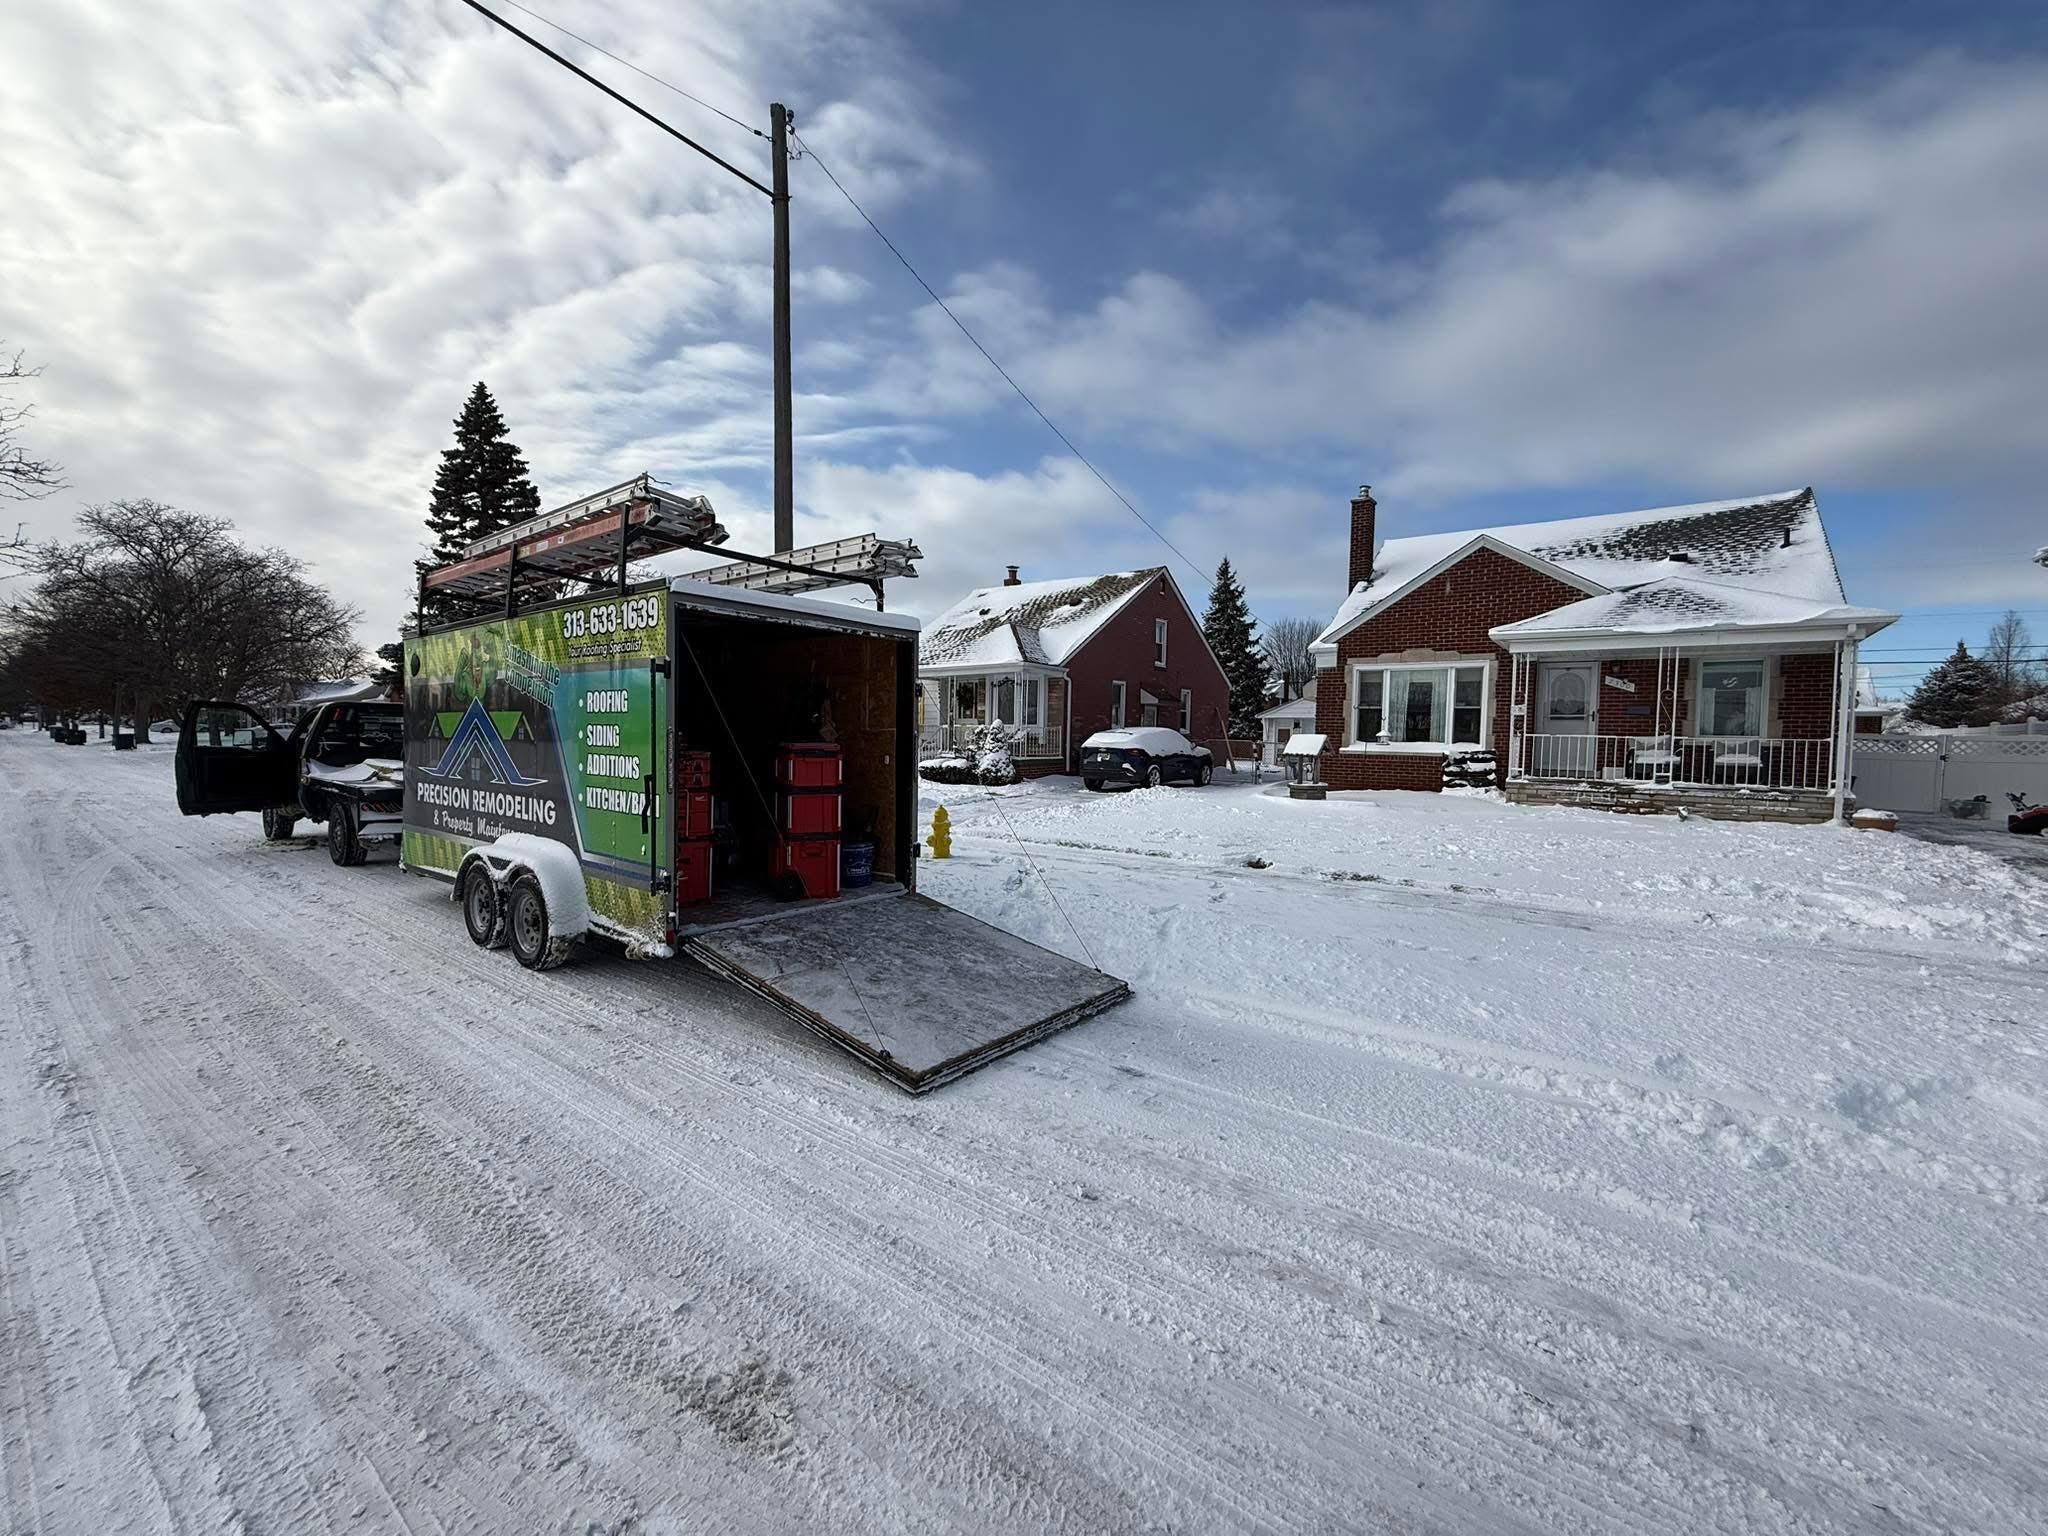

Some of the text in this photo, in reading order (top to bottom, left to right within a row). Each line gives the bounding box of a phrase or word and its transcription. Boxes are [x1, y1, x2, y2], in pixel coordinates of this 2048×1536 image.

[563, 596, 659, 638] 313-633-1639
[569, 638, 641, 657] Your Roofing Specialist
[504, 639, 560, 687] Smashing the
[504, 663, 556, 709] Competition
[586, 690, 628, 713] ROOFING
[586, 724, 620, 748] SIDING
[586, 754, 640, 779] ADDITIONS
[417, 782, 556, 825] PRECISION REMODELING
[586, 786, 660, 817] KITCHEN/BA
[433, 809, 440, 825] &
[442, 810, 474, 837] Property
